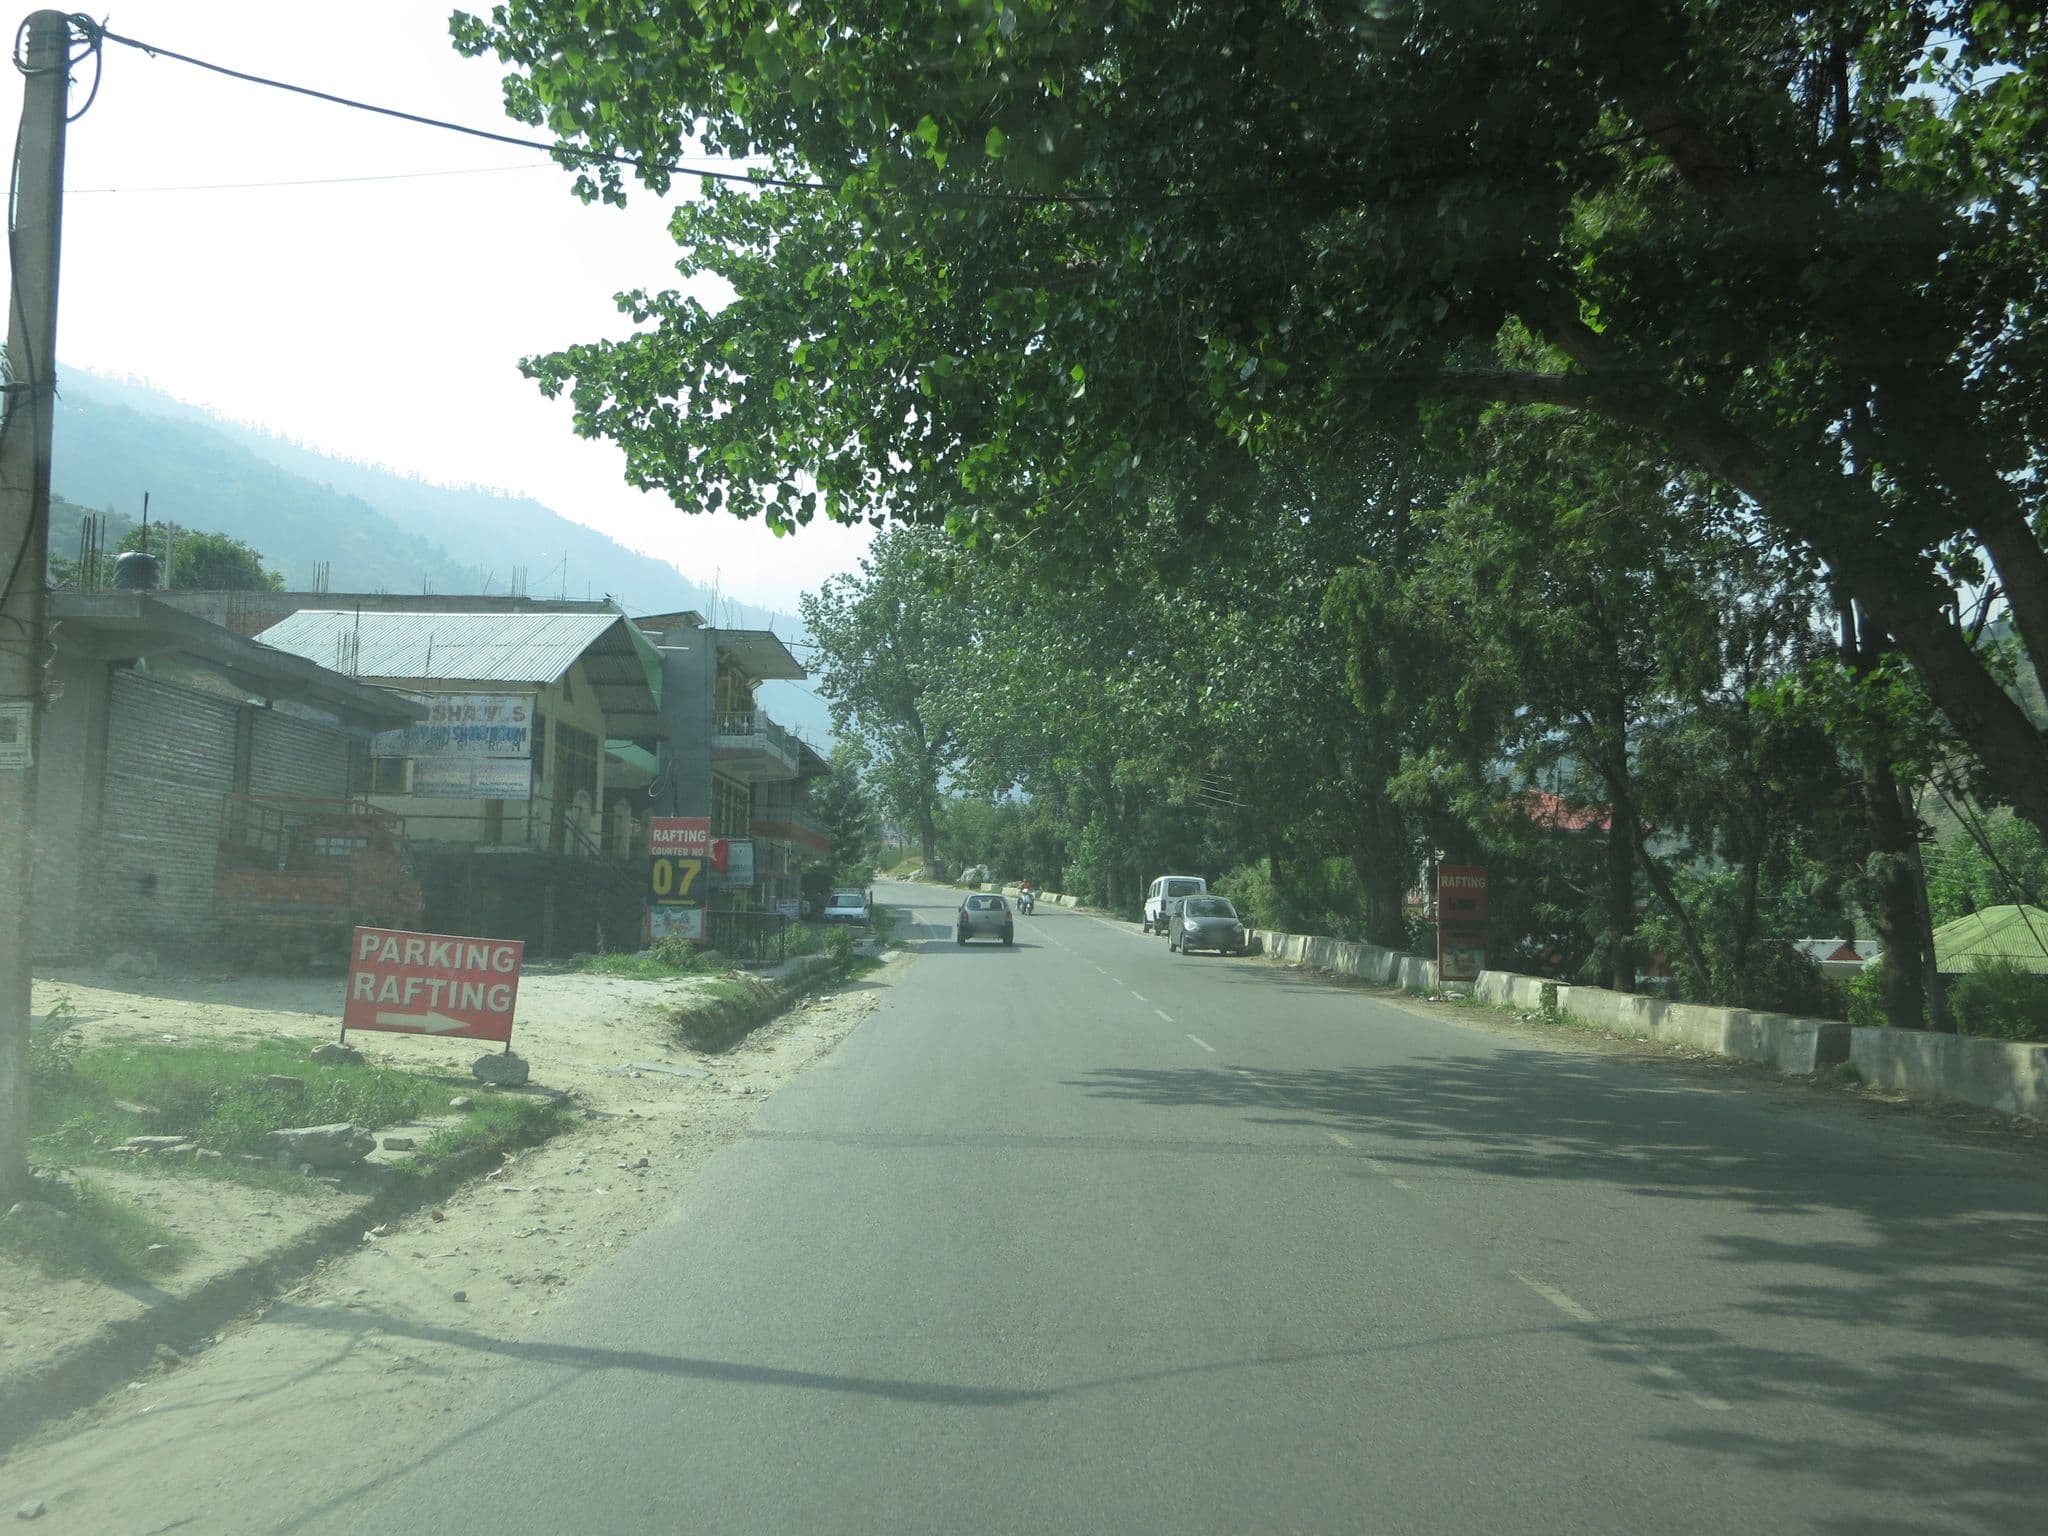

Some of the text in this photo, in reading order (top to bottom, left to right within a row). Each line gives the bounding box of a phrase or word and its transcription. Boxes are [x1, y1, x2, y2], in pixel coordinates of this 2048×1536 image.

[653, 829, 706, 842] RAFTING
[651, 846, 704, 856] COUNTER NO
[652, 858, 701, 896] 07
[1441, 875, 1486, 888] RAFTING
[359, 934, 515, 973] PARKING
[353, 972, 511, 1012] RAFTING
